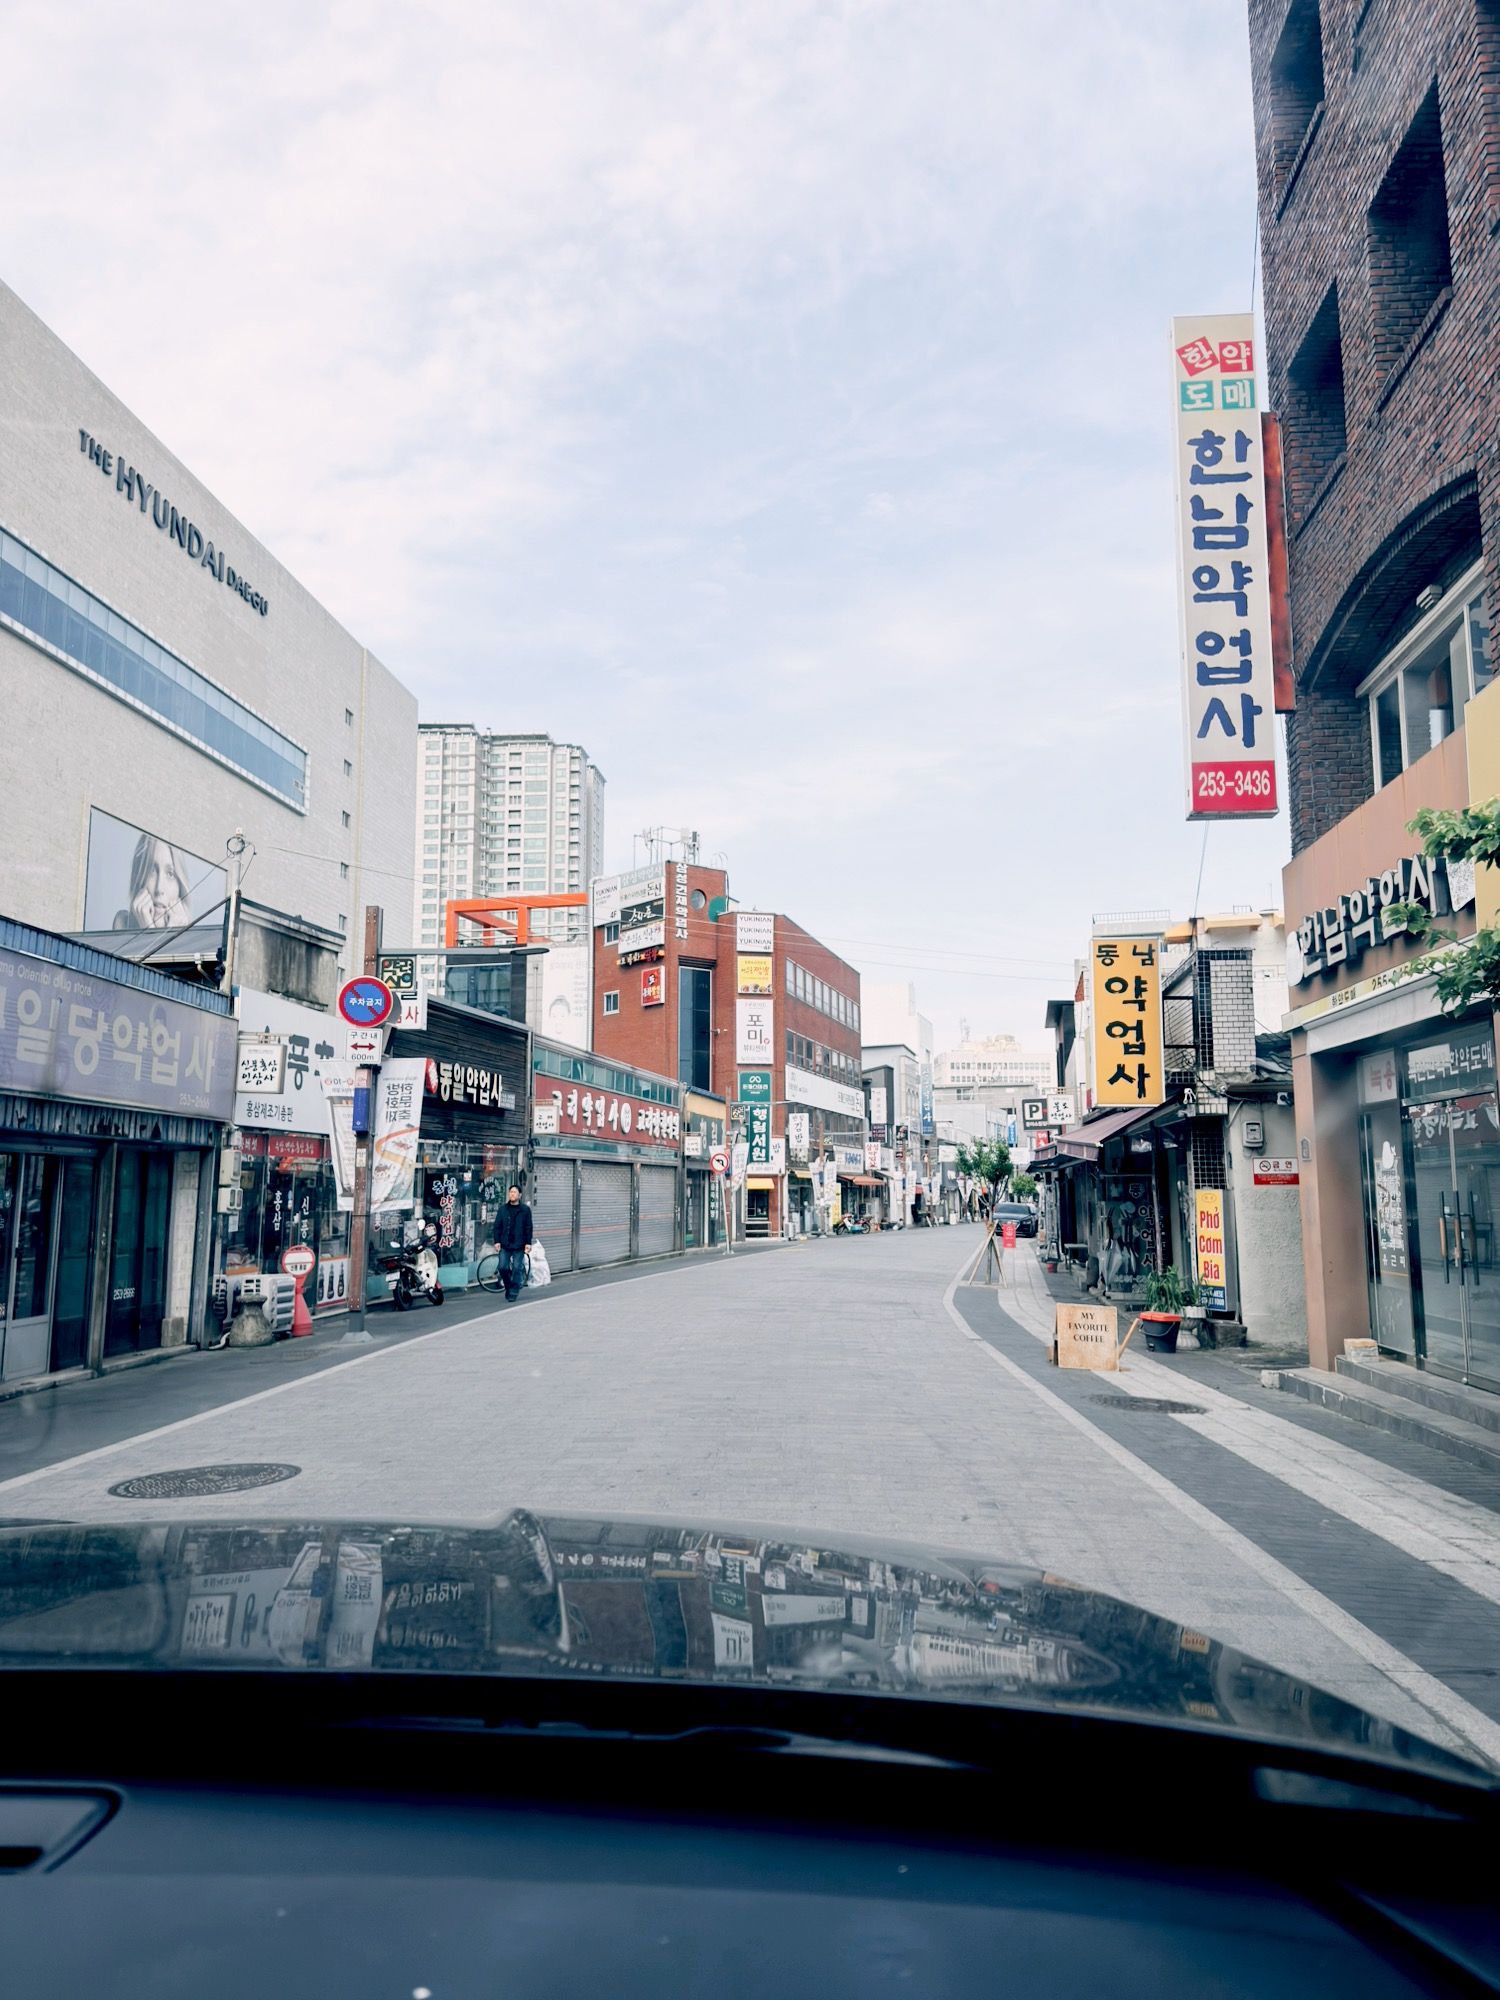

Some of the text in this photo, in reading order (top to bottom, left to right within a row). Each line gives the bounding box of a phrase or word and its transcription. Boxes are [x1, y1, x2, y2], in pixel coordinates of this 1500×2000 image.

[1181, 341, 1251, 373] 한약
[1184, 380, 1252, 410] 도매
[79, 428, 268, 617] THE HYUNDAI DAEGU
[1186, 429, 1264, 749] 한남약업사
[1198, 771, 1271, 798] 253-3436
[74, 981, 92, 997] store
[349, 997, 382, 1007] 주차금지
[1103, 975, 1151, 1100] 약업사
[351, 1053, 375, 1061] 600m
[439, 1062, 503, 1110] 동일약업사
[751, 1107, 768, 1162] 행림서원
[1200, 1207, 1221, 1230] Phở
[1199, 1234, 1223, 1256] Cơm
[1203, 1260, 1220, 1280] Bia
[1068, 1322, 1109, 1332] FAVORITE
[1081, 1312, 1095, 1320] MY
[1073, 1334, 1104, 1343] COFFEE
